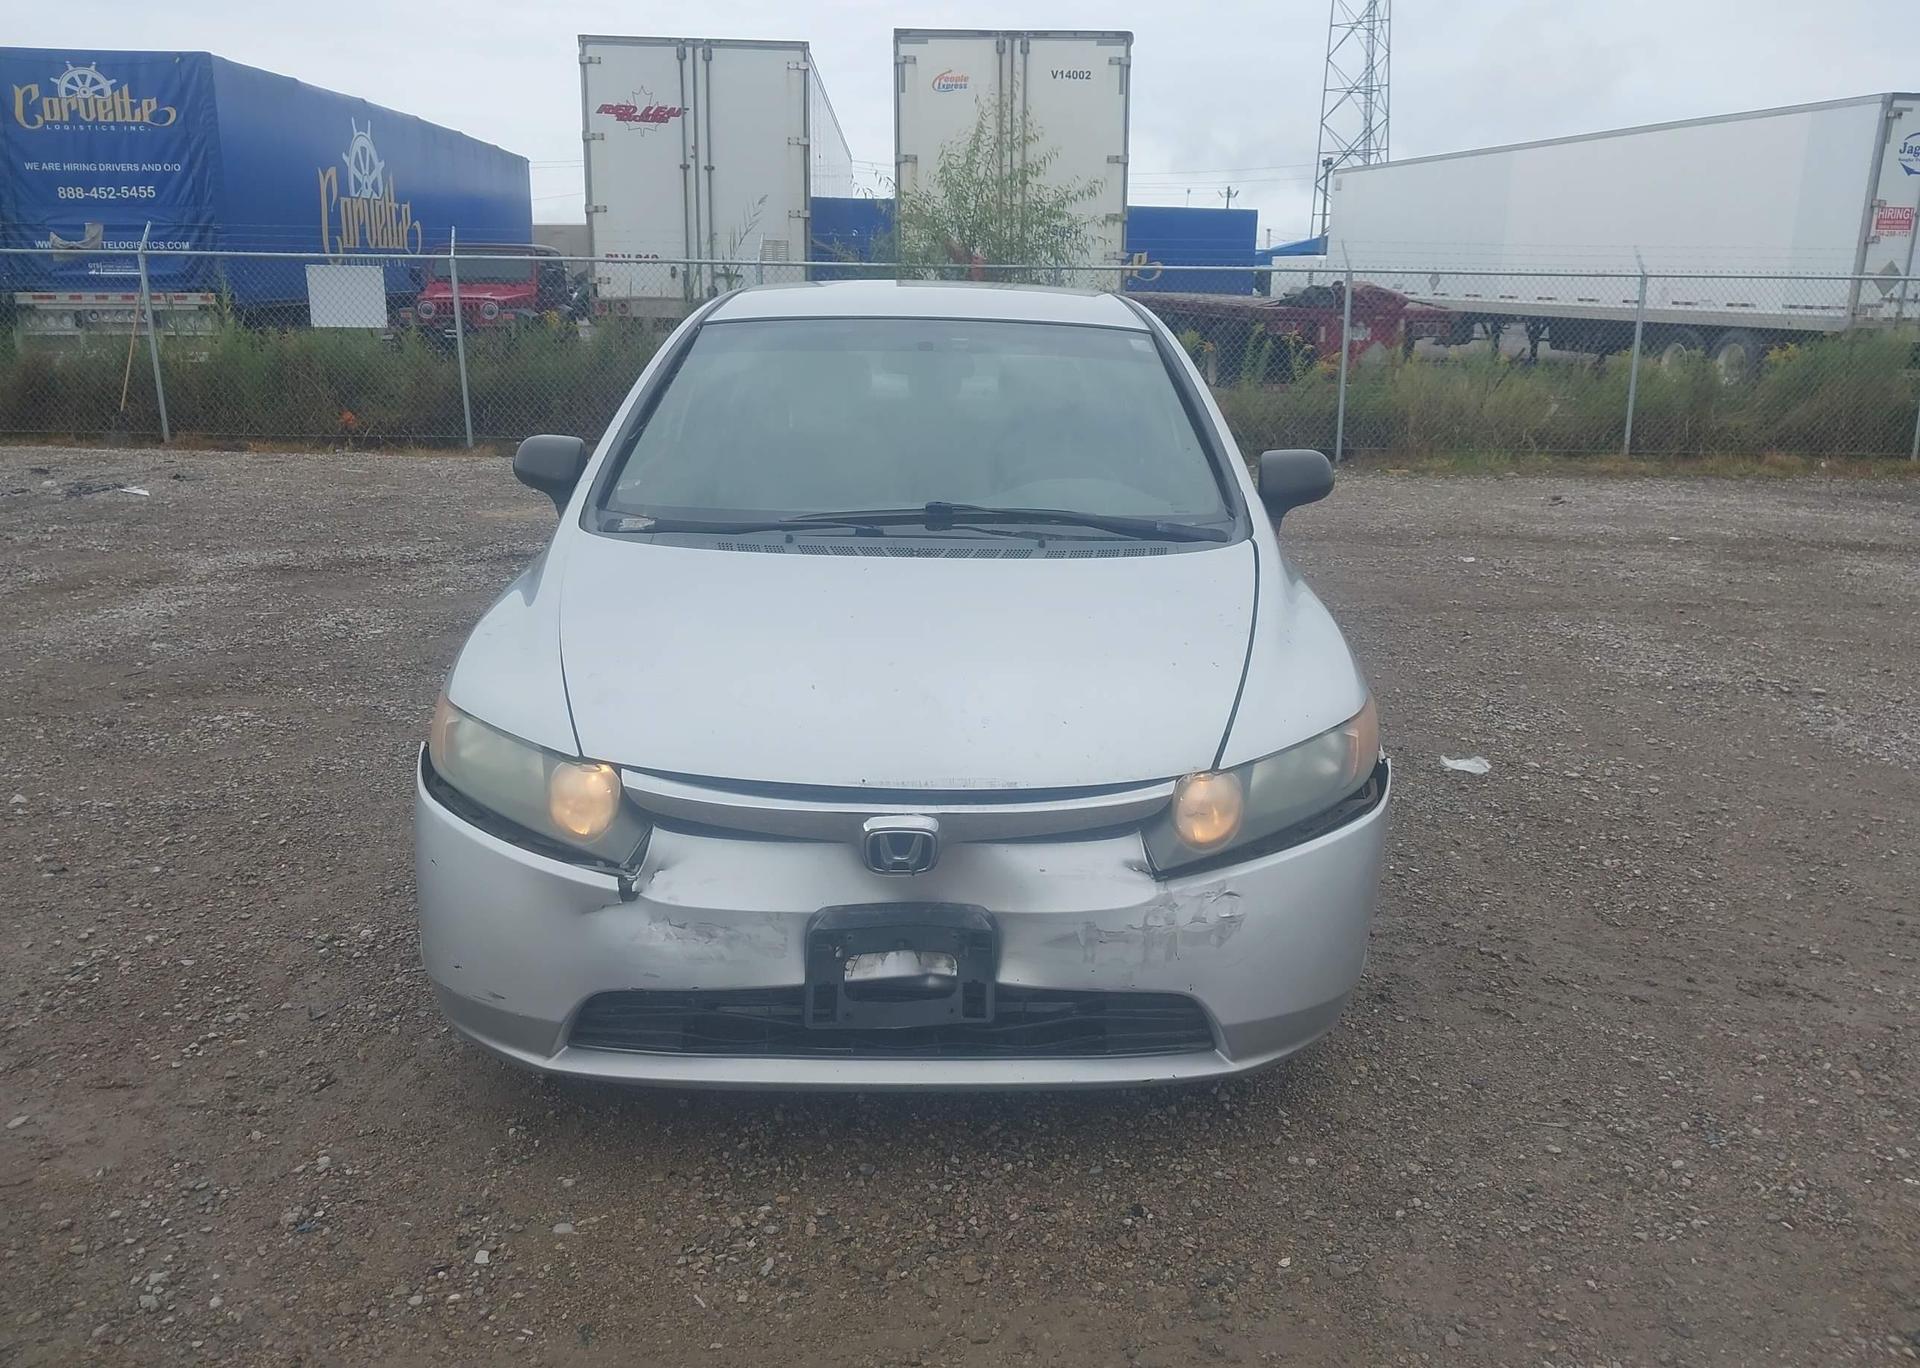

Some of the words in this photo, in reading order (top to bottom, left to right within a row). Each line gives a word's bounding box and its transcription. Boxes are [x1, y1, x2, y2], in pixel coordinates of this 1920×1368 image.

[1051, 70, 1091, 80] V14002
[12, 83, 177, 129] Corvette
[25, 162, 40, 171] WE
[42, 162, 61, 171] ARE
[63, 162, 97, 172] HIRING
[99, 163, 139, 172] DRIVERS
[141, 163, 162, 172] AND
[163, 163, 181, 173] O/O
[57, 186, 156, 200] 888-452-5455
[1878, 208, 1914, 220] HIRING!
